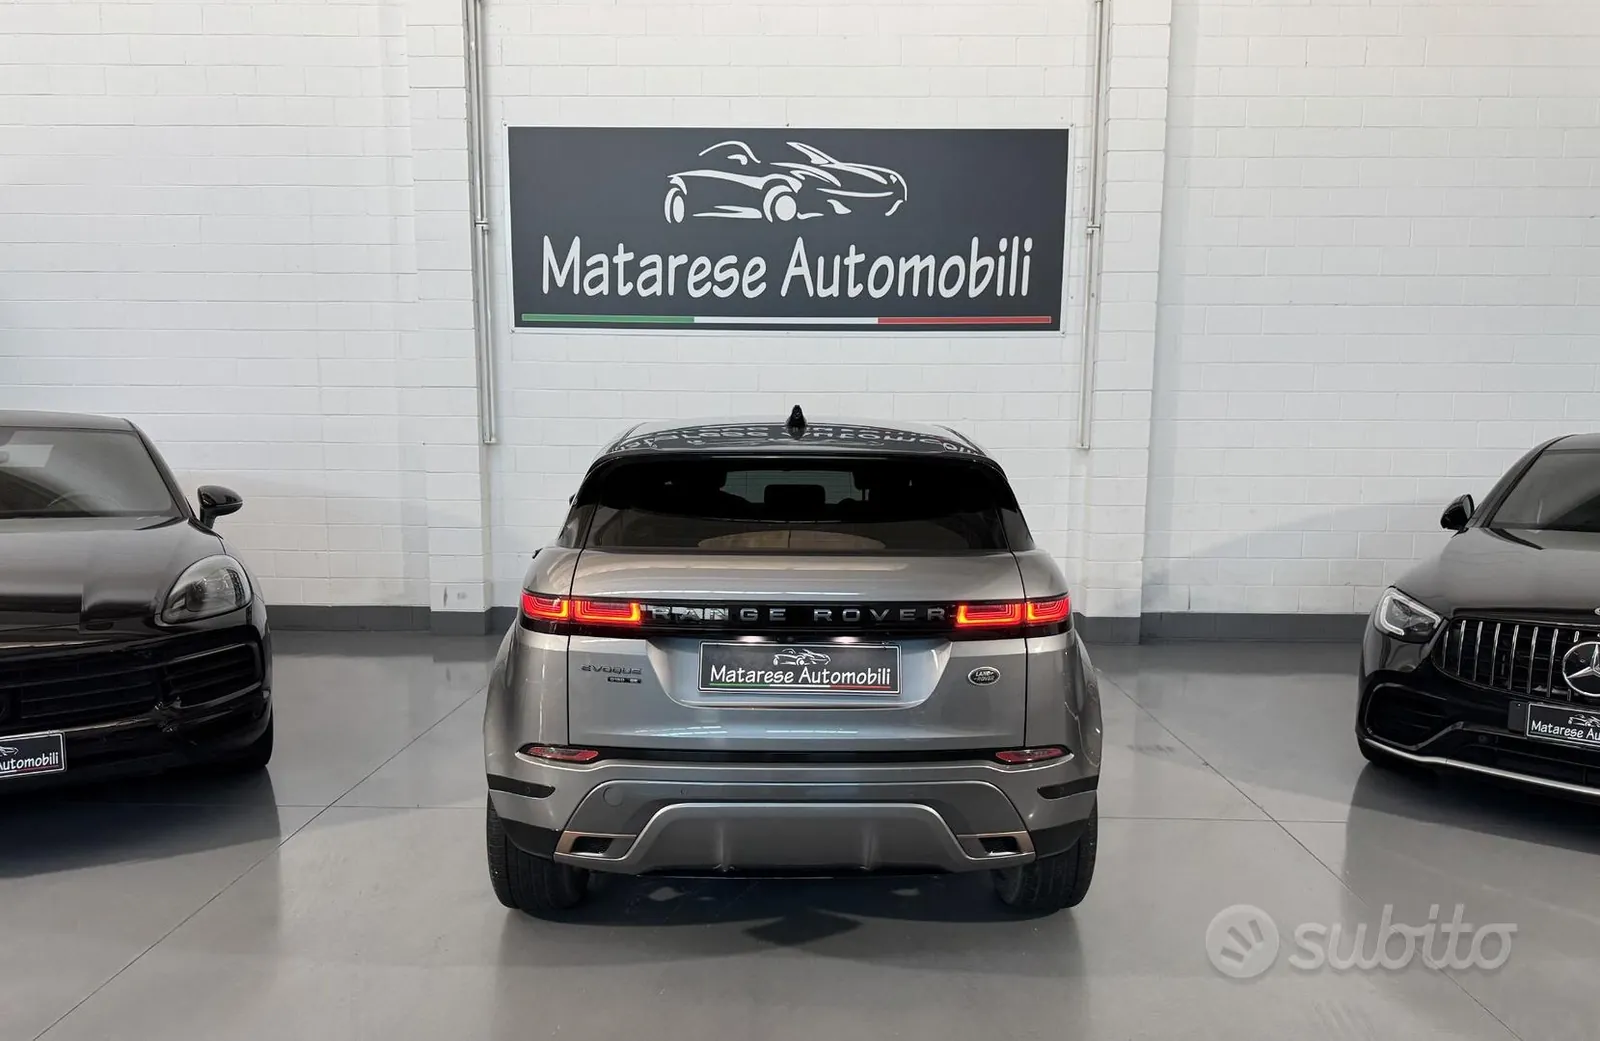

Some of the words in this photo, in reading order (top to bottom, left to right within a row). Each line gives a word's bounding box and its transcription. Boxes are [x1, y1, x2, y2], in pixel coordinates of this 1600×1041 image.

[543, 235, 767, 298] Matarese
[780, 236, 1033, 298] Automobili
[652, 606, 786, 620] RANGE
[813, 608, 945, 621] ROVER
[710, 664, 794, 684] Matarese
[798, 666, 891, 685] Automobili
[1531, 720, 1584, 738] Matarese
